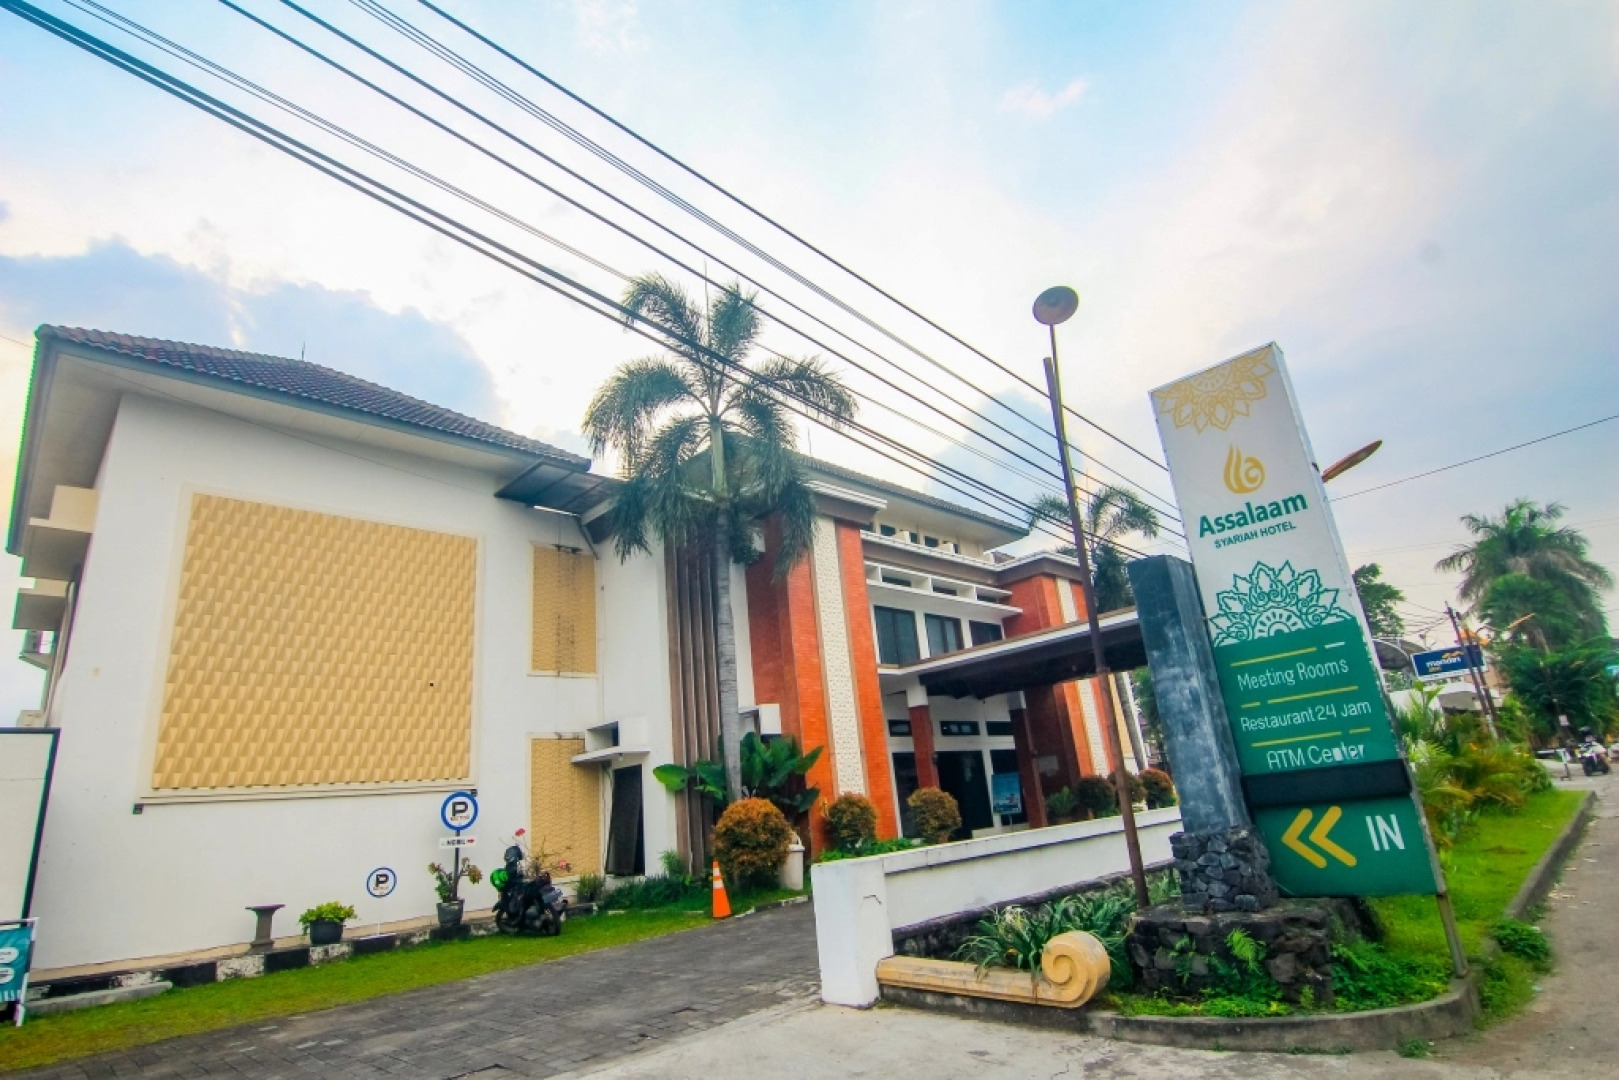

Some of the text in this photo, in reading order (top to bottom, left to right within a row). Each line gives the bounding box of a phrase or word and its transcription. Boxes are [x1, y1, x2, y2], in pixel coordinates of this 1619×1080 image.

[1199, 493, 1308, 538] Assalaam
[1214, 521, 1298, 549] SYARIAH HOTEL
[1237, 659, 1350, 691] Meeting Rooms
[1240, 701, 1372, 732] Restaurant 24 Jam
[1266, 747, 1307, 769] ATM
[452, 801, 468, 816] P
[1365, 813, 1405, 851] IN
[375, 874, 389, 887] P
